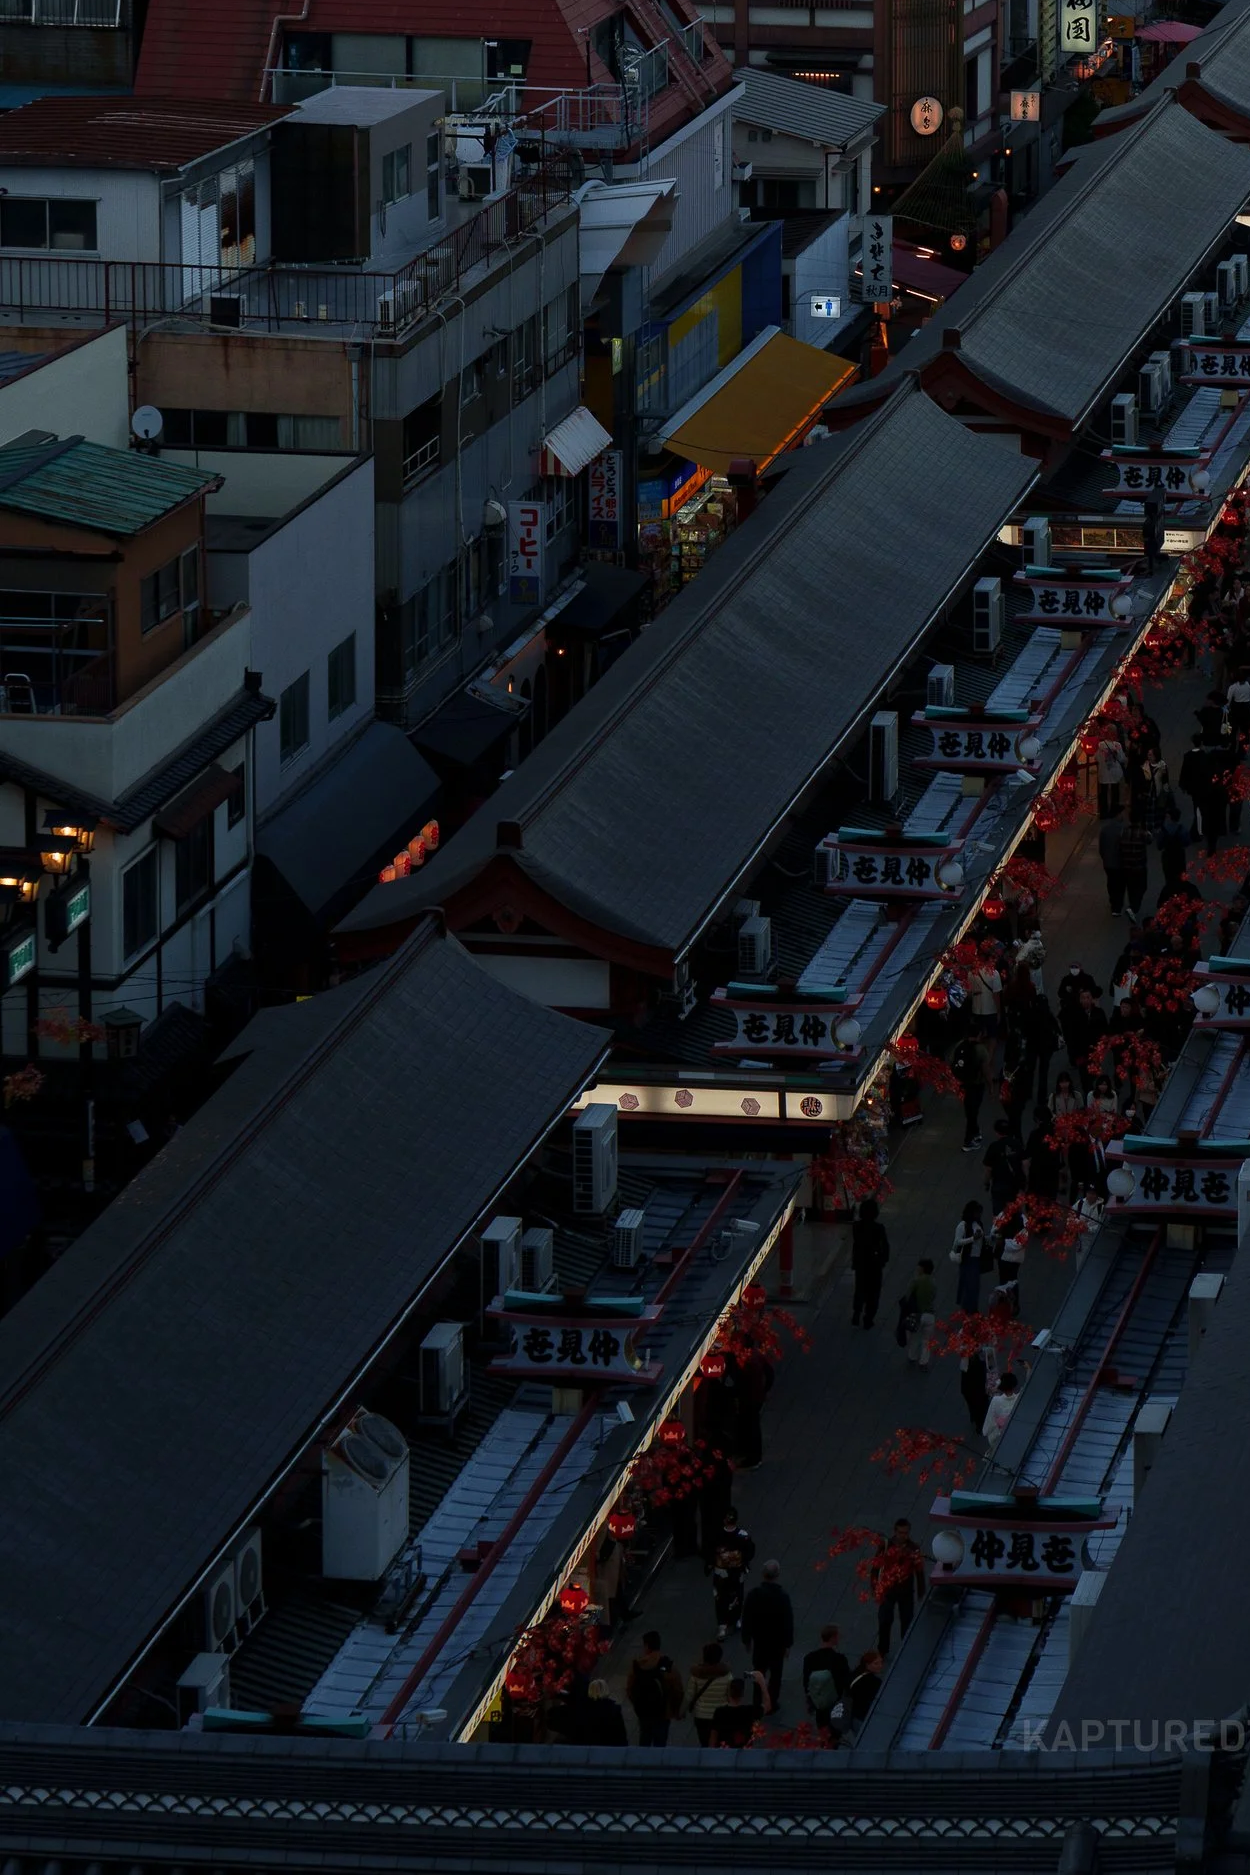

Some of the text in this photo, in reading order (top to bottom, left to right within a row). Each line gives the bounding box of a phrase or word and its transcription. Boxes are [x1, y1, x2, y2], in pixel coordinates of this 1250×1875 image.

[865, 284, 888, 297] 秋月
[519, 508, 538, 570] コーヒー
